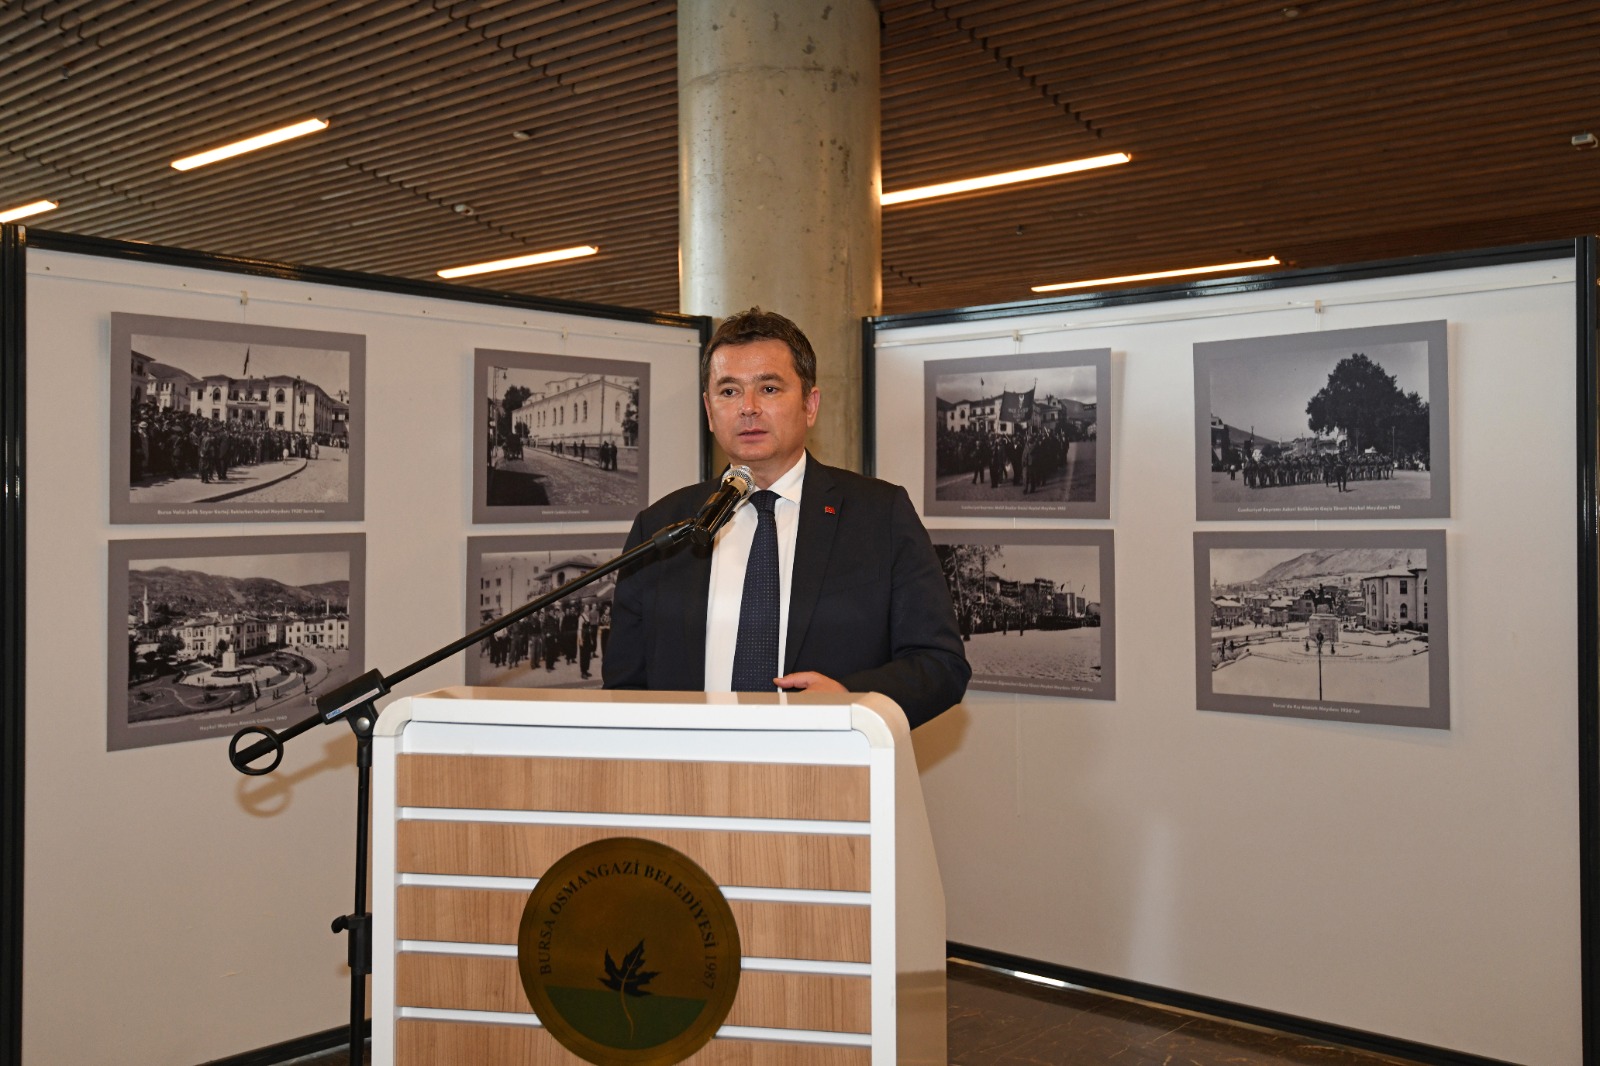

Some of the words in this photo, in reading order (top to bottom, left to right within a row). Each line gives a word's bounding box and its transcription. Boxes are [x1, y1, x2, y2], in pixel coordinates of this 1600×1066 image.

[538, 917, 556, 977] BURSA
[549, 858, 640, 917] OSMANGAZİ
[643, 864, 720, 949] BELEDİYESİ
[702, 954, 719, 990] 1987
